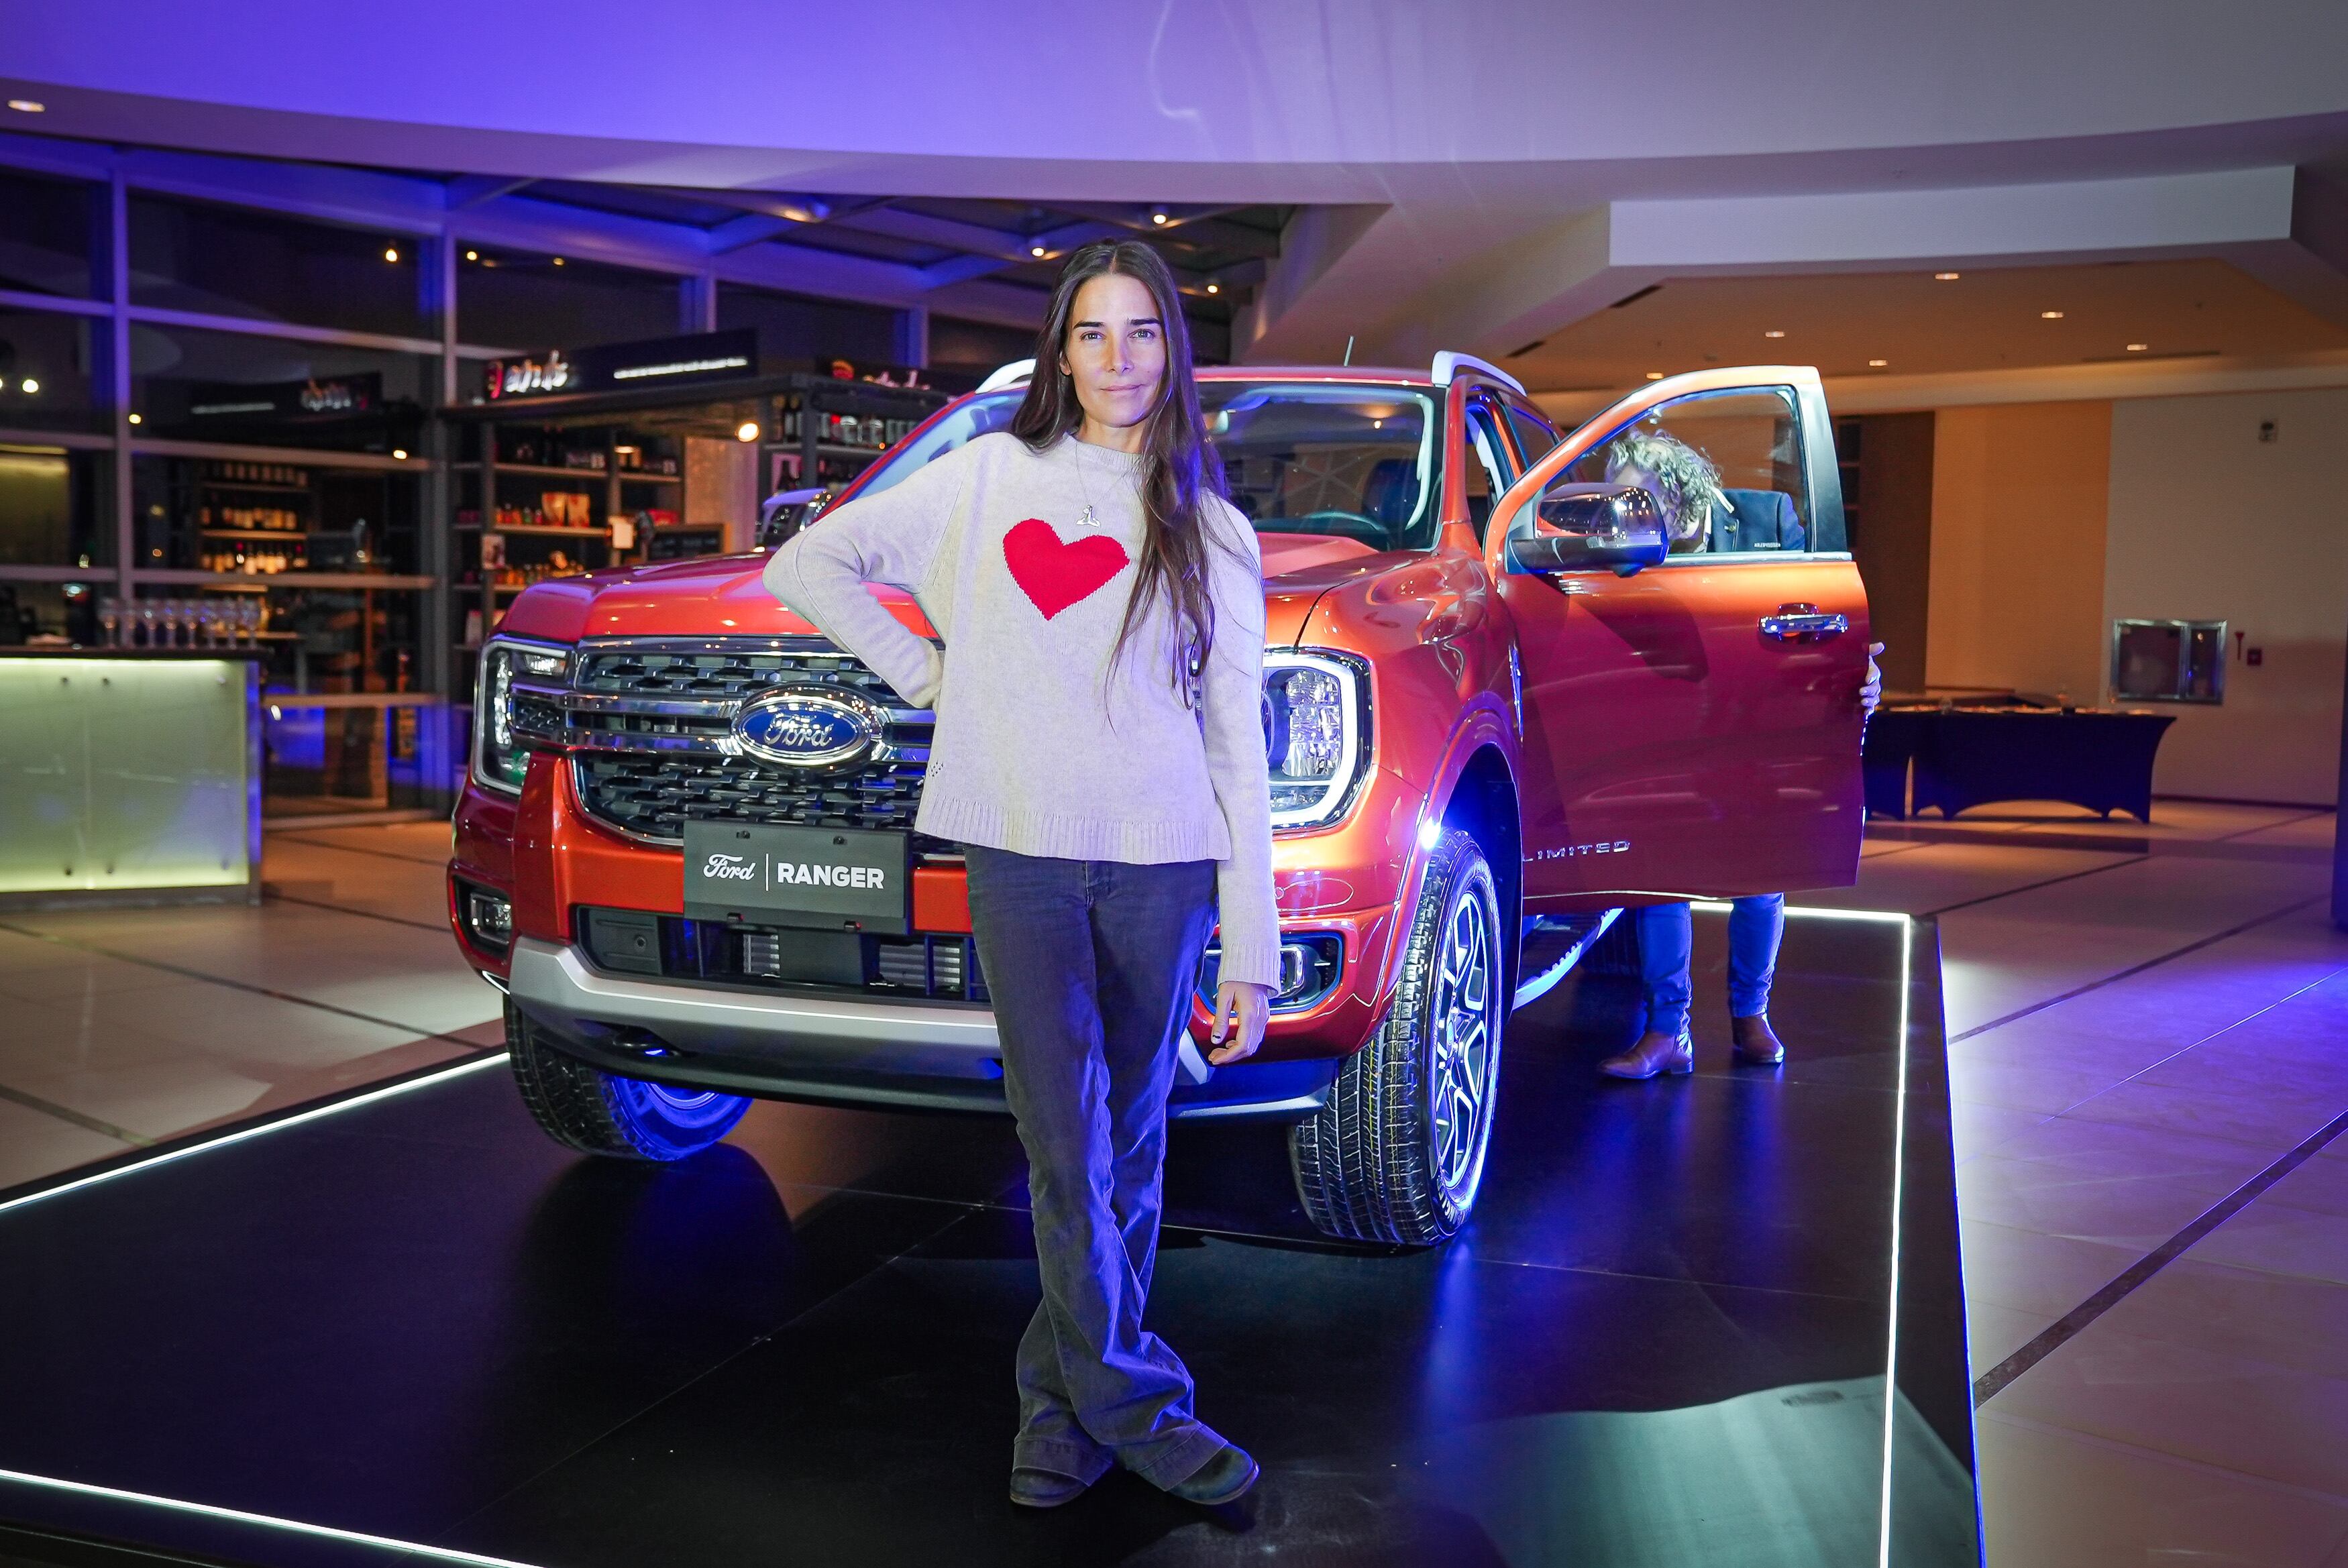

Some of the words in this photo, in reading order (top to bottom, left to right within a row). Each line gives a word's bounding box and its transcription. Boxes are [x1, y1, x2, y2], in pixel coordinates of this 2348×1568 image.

[764, 712, 835, 746] Ford
[1522, 840, 1630, 862] LIMITED
[703, 854, 756, 881] Ford
[778, 862, 885, 889] RANGER
